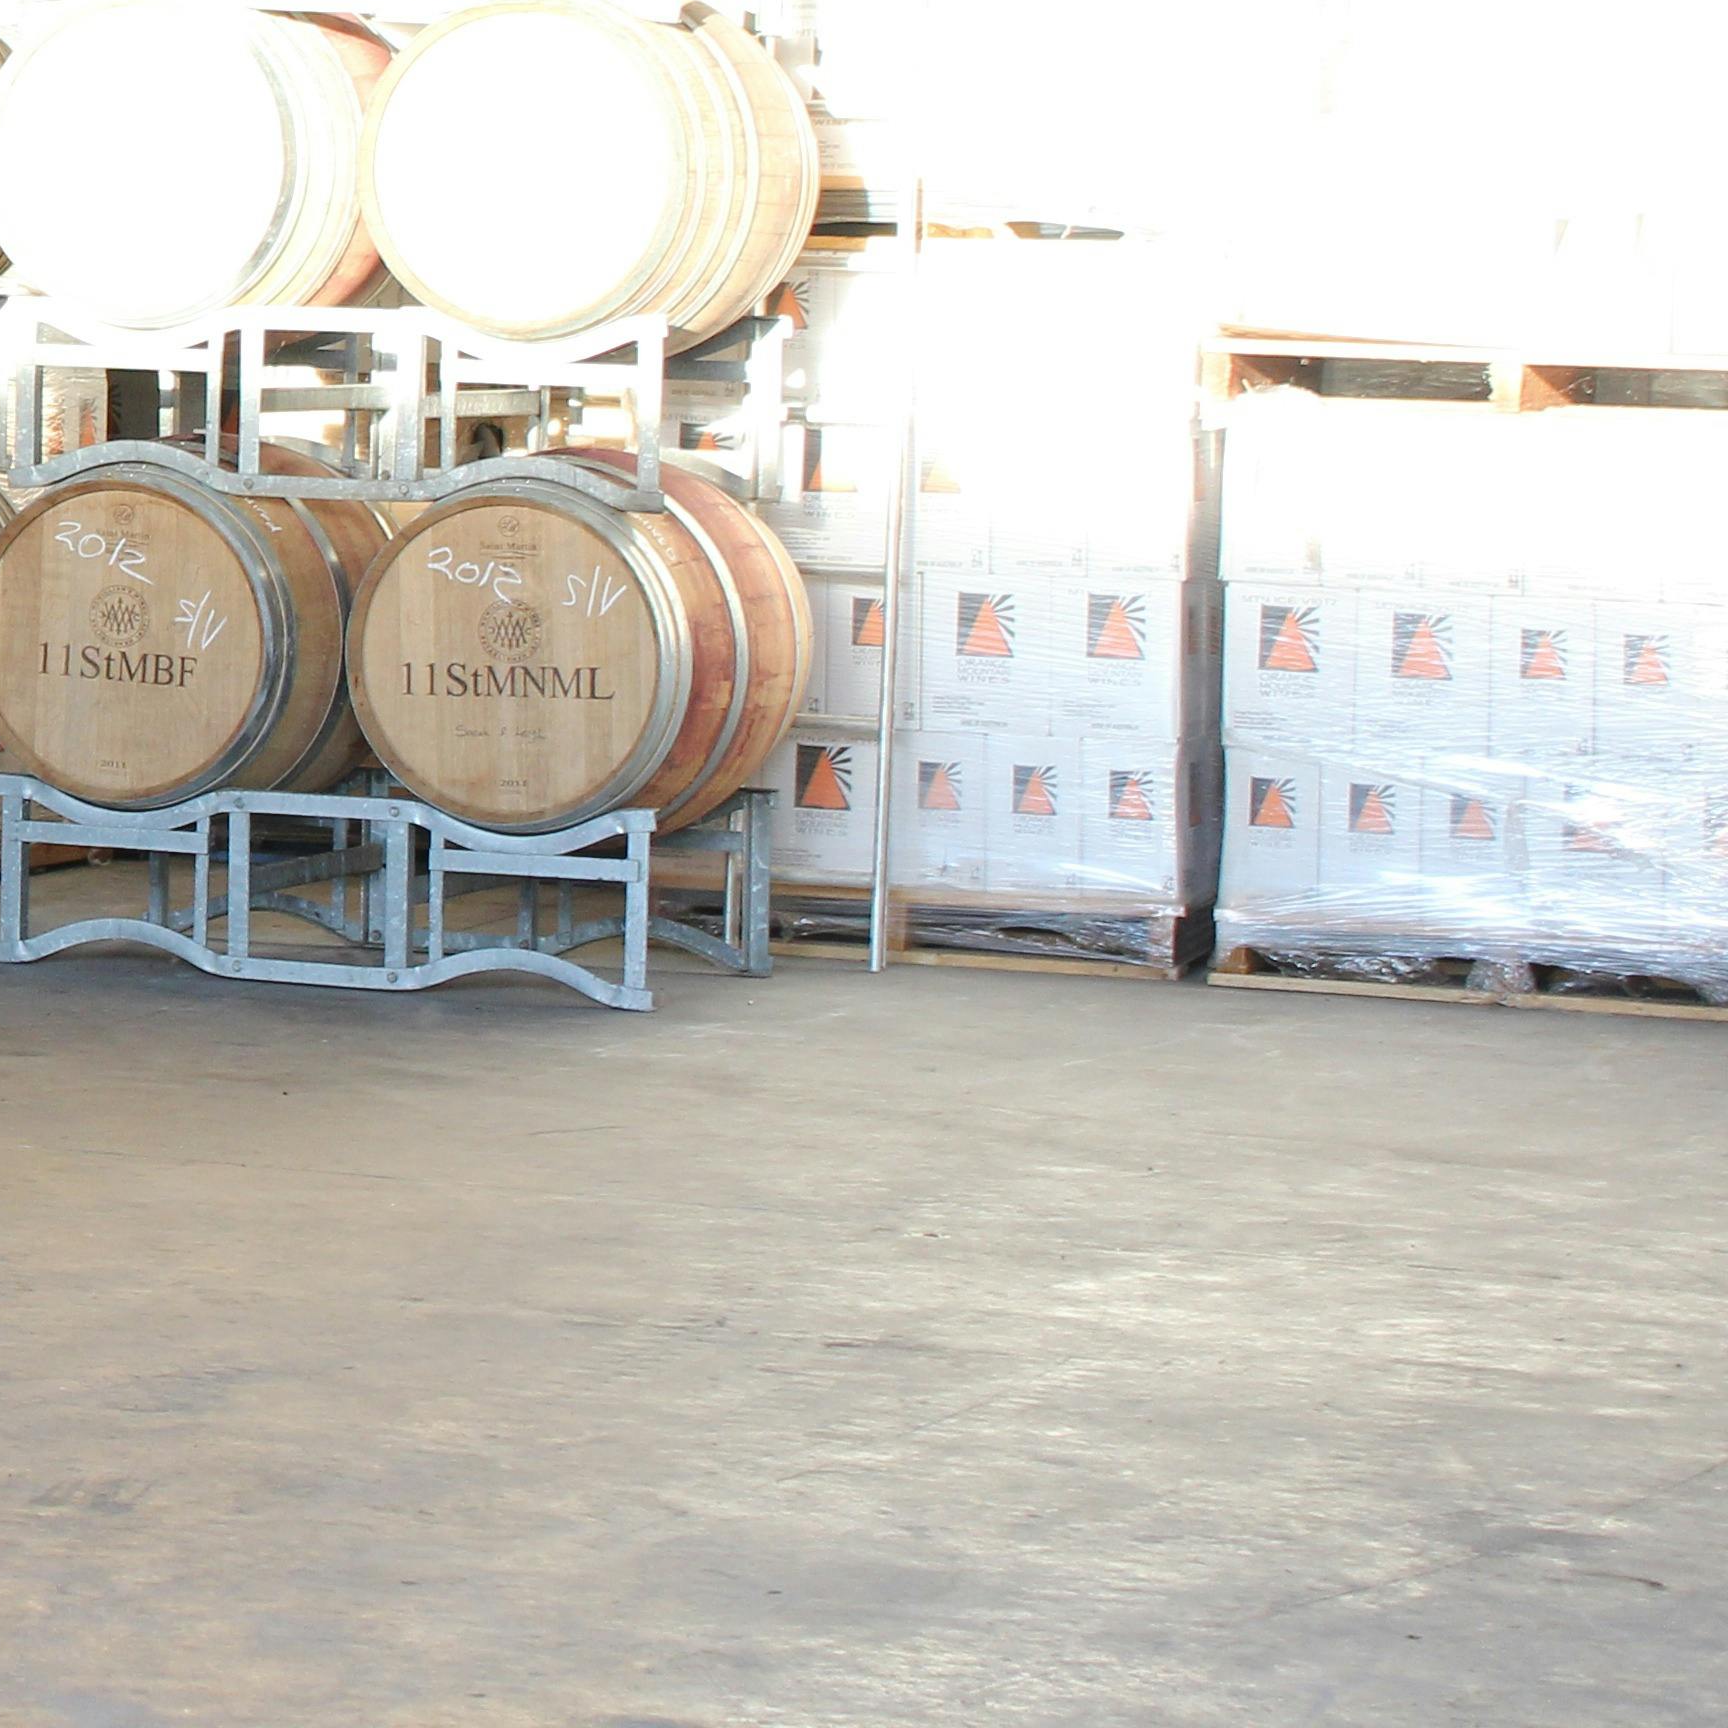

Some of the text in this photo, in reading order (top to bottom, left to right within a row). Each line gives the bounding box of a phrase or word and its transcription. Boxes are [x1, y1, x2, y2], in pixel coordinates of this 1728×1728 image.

[55, 522, 155, 586] 2012
[427, 546, 523, 605] 2012
[39, 641, 198, 688] 11StMBF
[402, 662, 616, 700] 11StMNML
